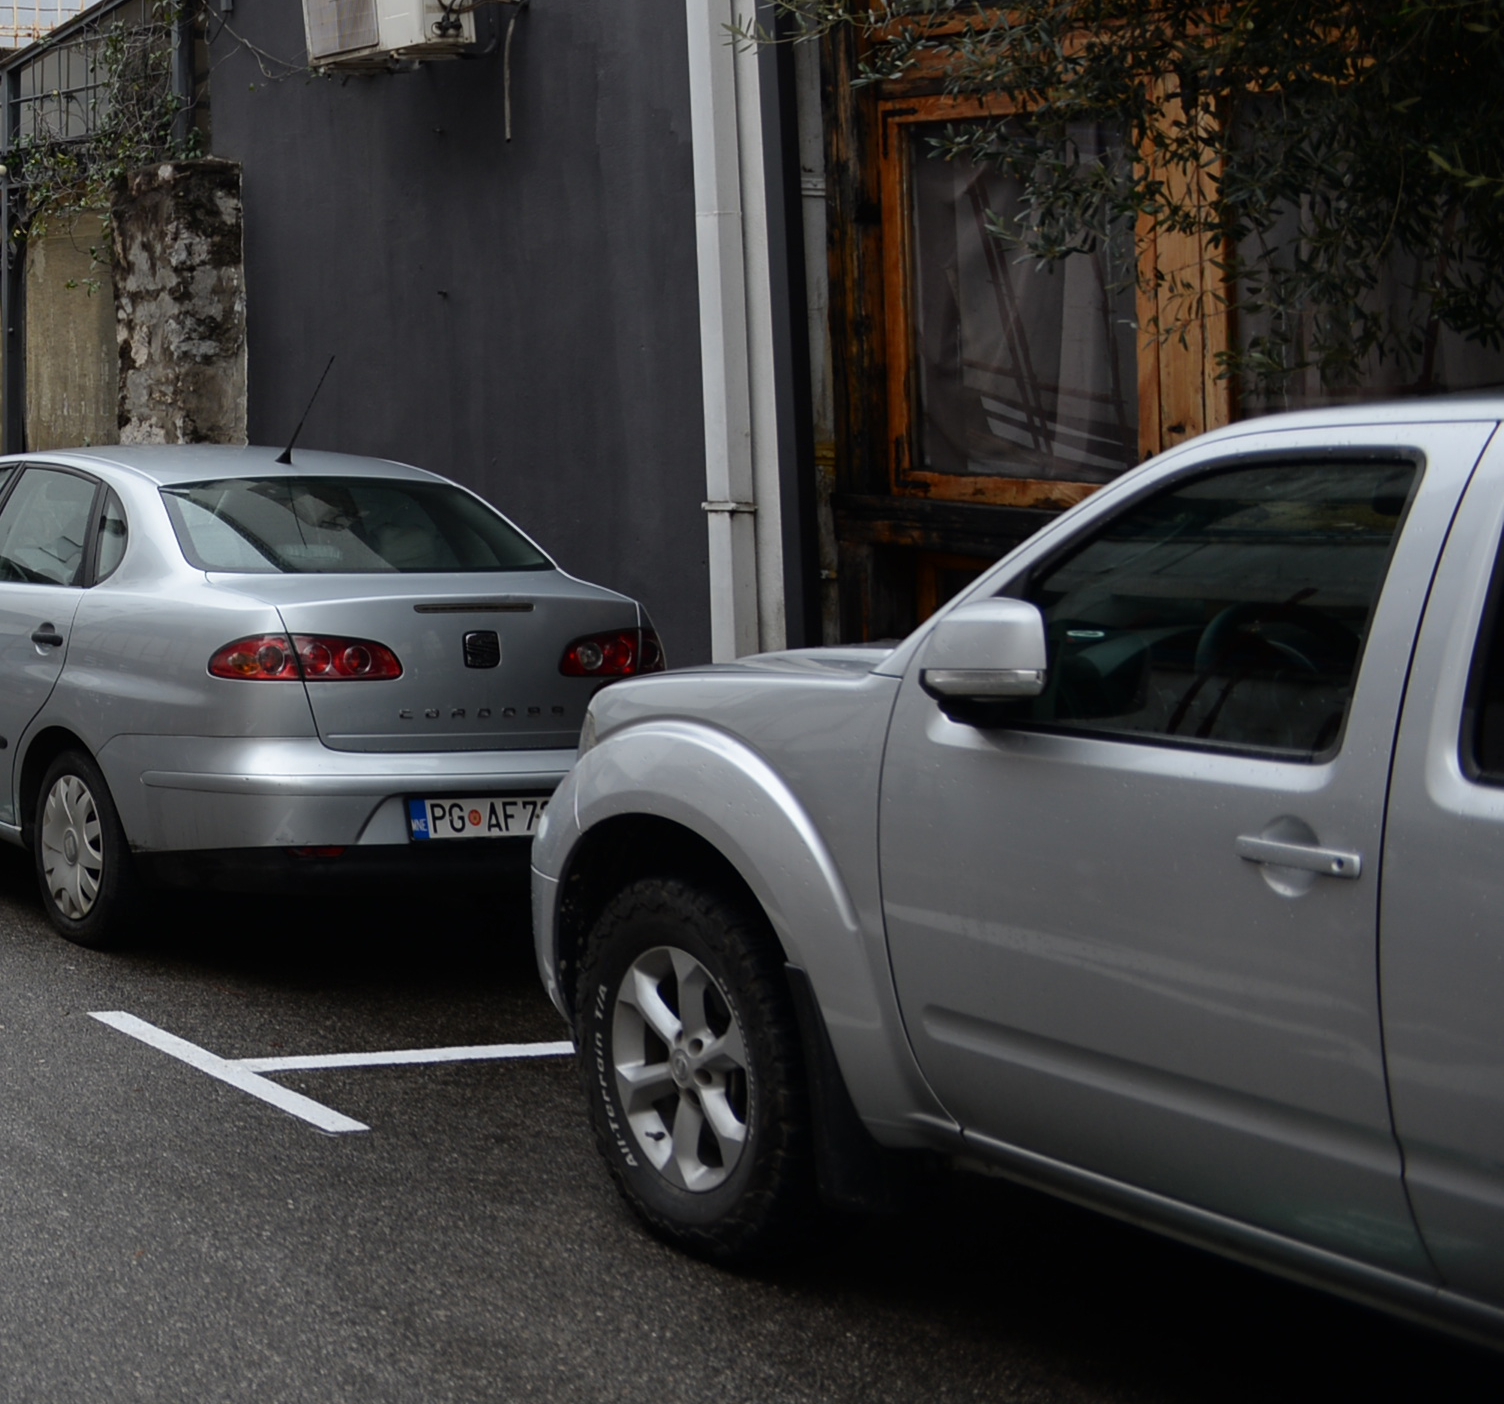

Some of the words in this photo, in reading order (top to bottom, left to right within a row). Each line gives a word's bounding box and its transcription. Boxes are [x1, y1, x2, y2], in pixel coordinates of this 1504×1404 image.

[429, 802, 467, 834] PG
[487, 800, 550, 833] AF7
[595, 983, 608, 1021] T/A
[597, 1032, 638, 1168] All-Terrain
